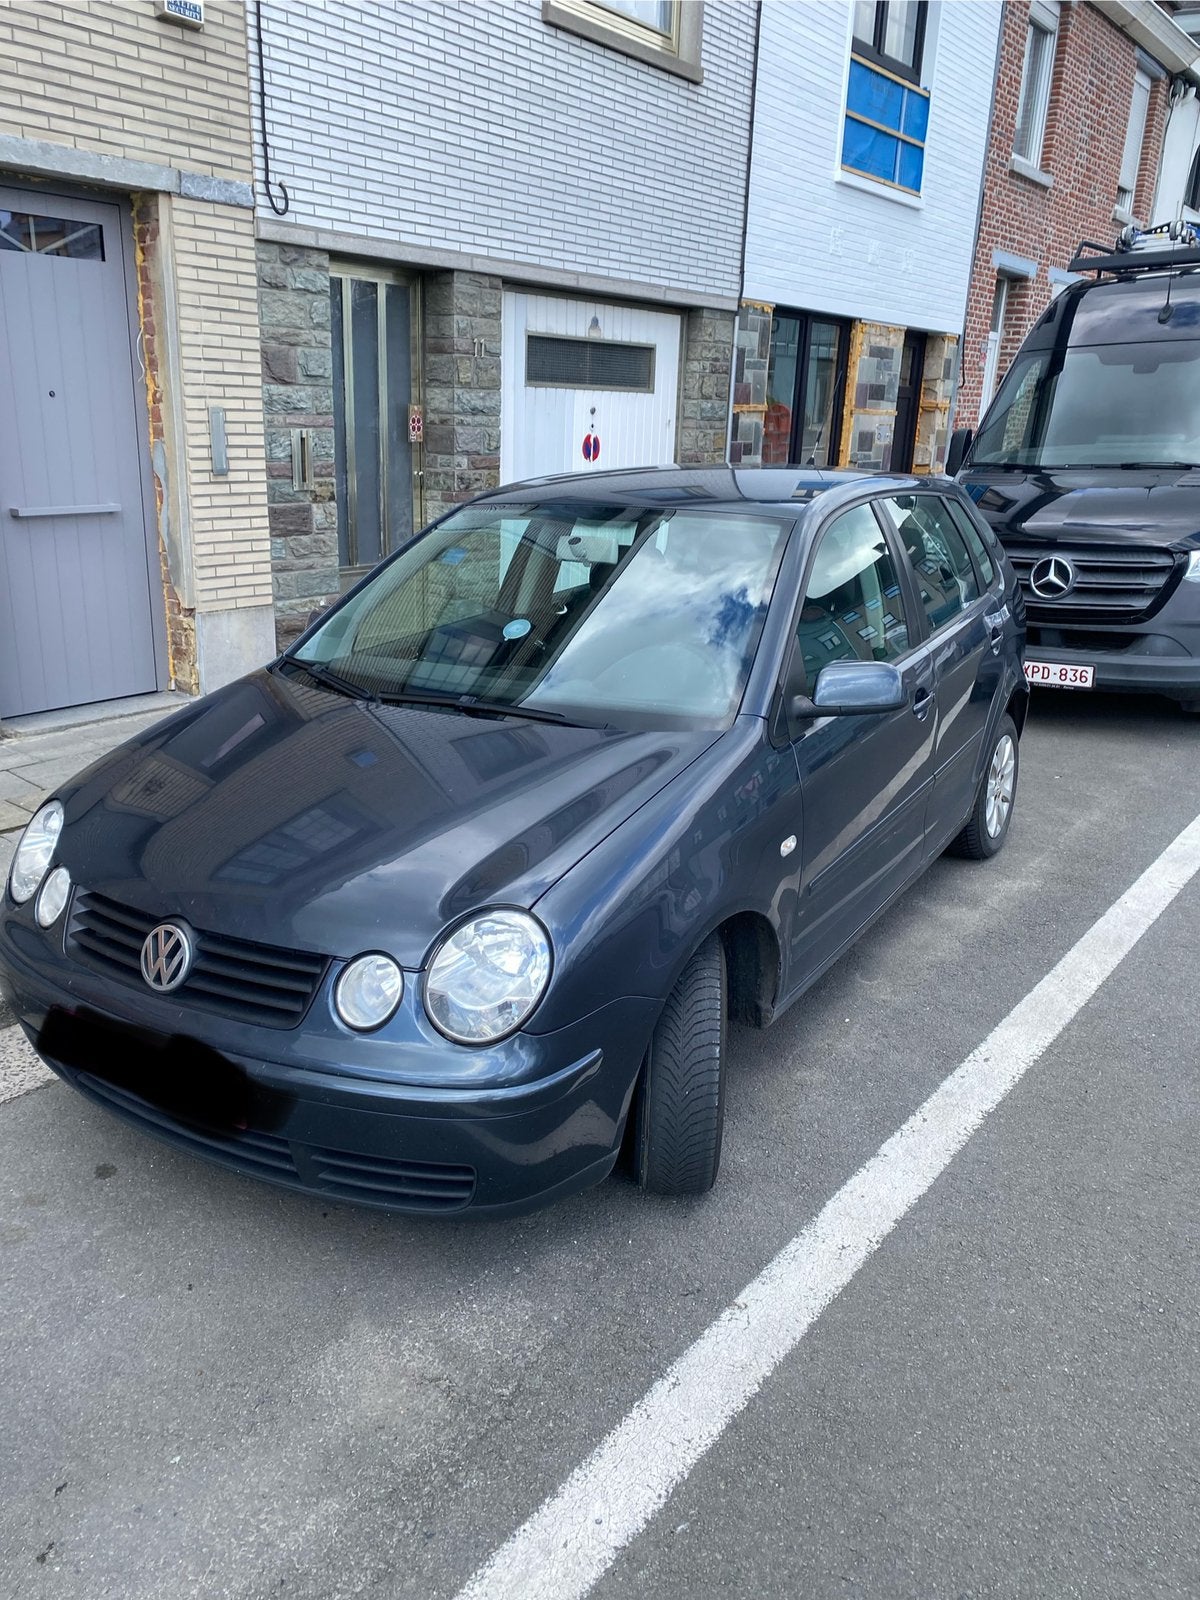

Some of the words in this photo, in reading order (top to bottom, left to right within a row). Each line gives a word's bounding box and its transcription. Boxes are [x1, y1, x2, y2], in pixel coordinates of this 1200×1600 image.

[168, 4, 200, 20] SECURITY
[473, 338, 485, 358] 11
[143, 926, 187, 989] VW
